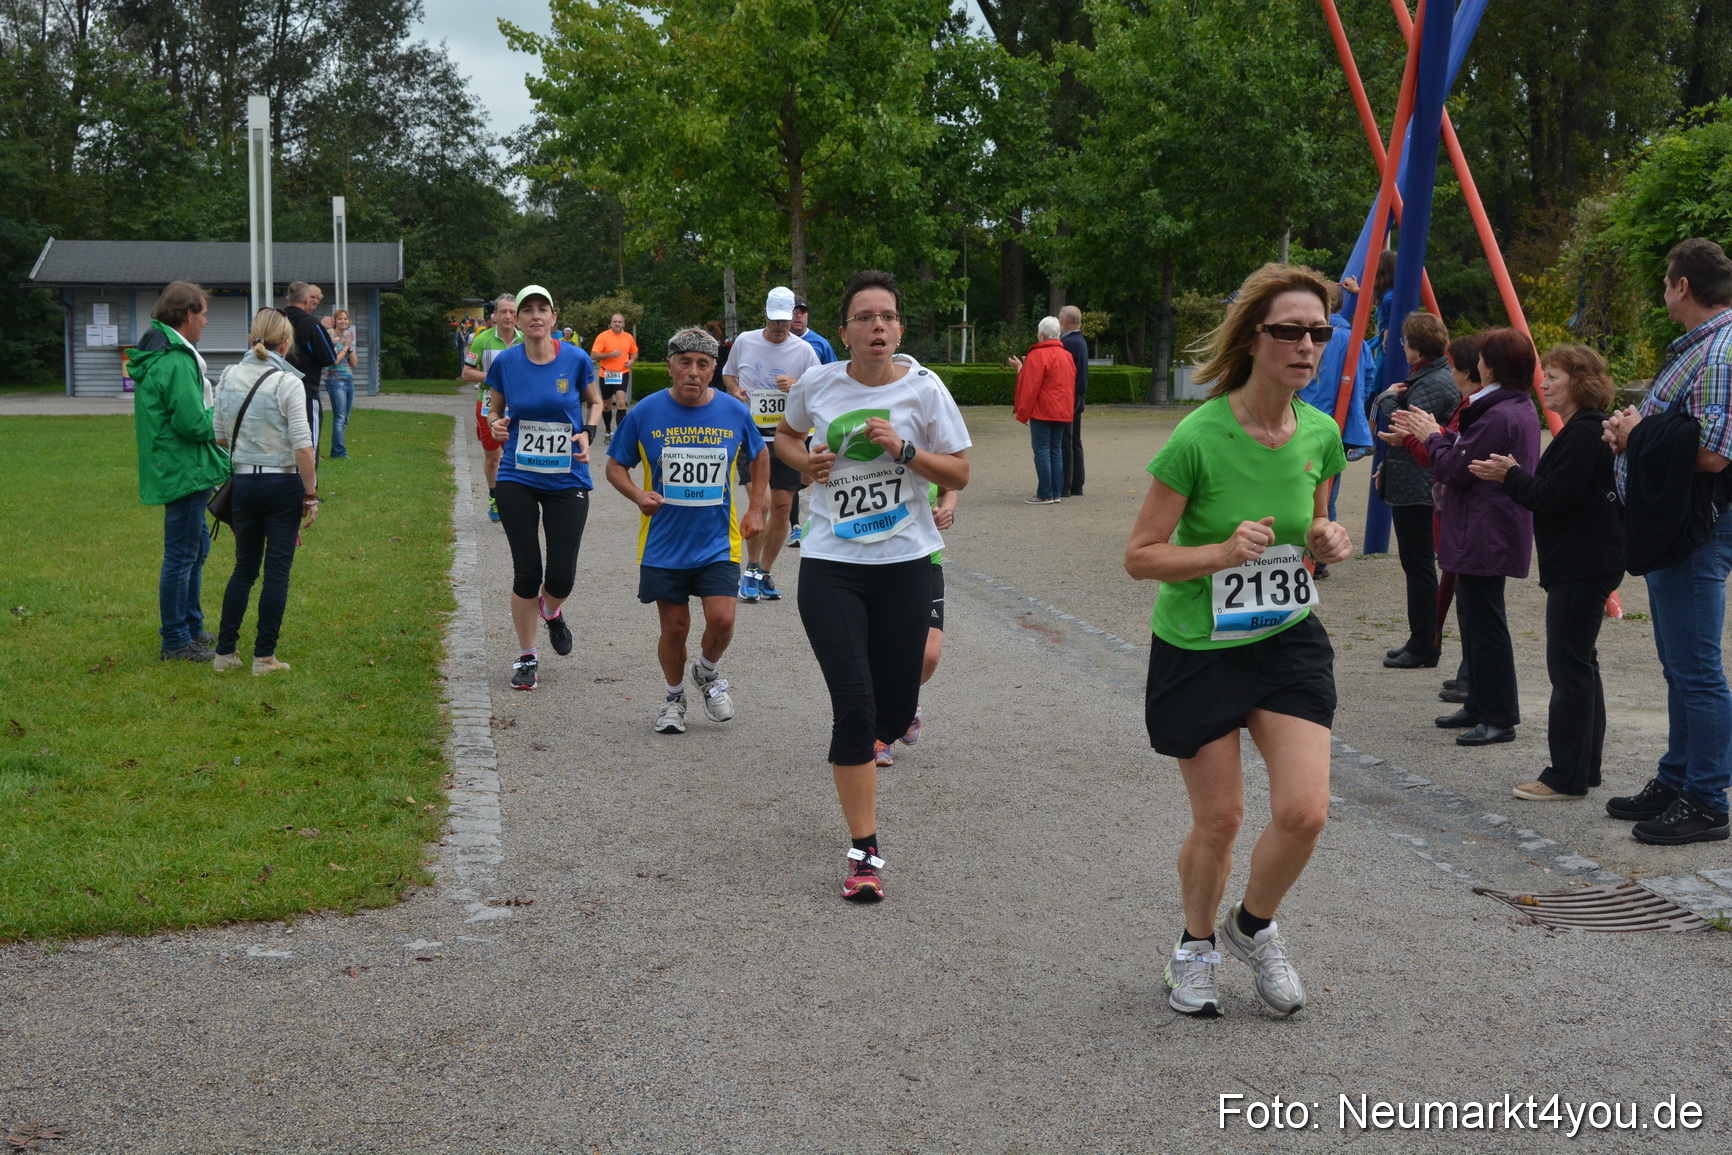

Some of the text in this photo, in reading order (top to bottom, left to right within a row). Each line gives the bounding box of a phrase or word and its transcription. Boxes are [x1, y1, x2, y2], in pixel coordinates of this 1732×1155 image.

[759, 398, 786, 413] 330
[651, 426, 734, 439] 10. NEUMARKTER
[522, 432, 567, 454] 2412
[664, 435, 722, 446] STADTLAUF
[527, 457, 559, 467] Krisztina
[669, 462, 722, 484] 2807
[851, 469, 893, 483] Neumarkt
[684, 488, 704, 498] Gerd
[833, 478, 903, 519] 2257
[853, 515, 897, 534] Cornelia
[1224, 567, 1311, 609] 2138
